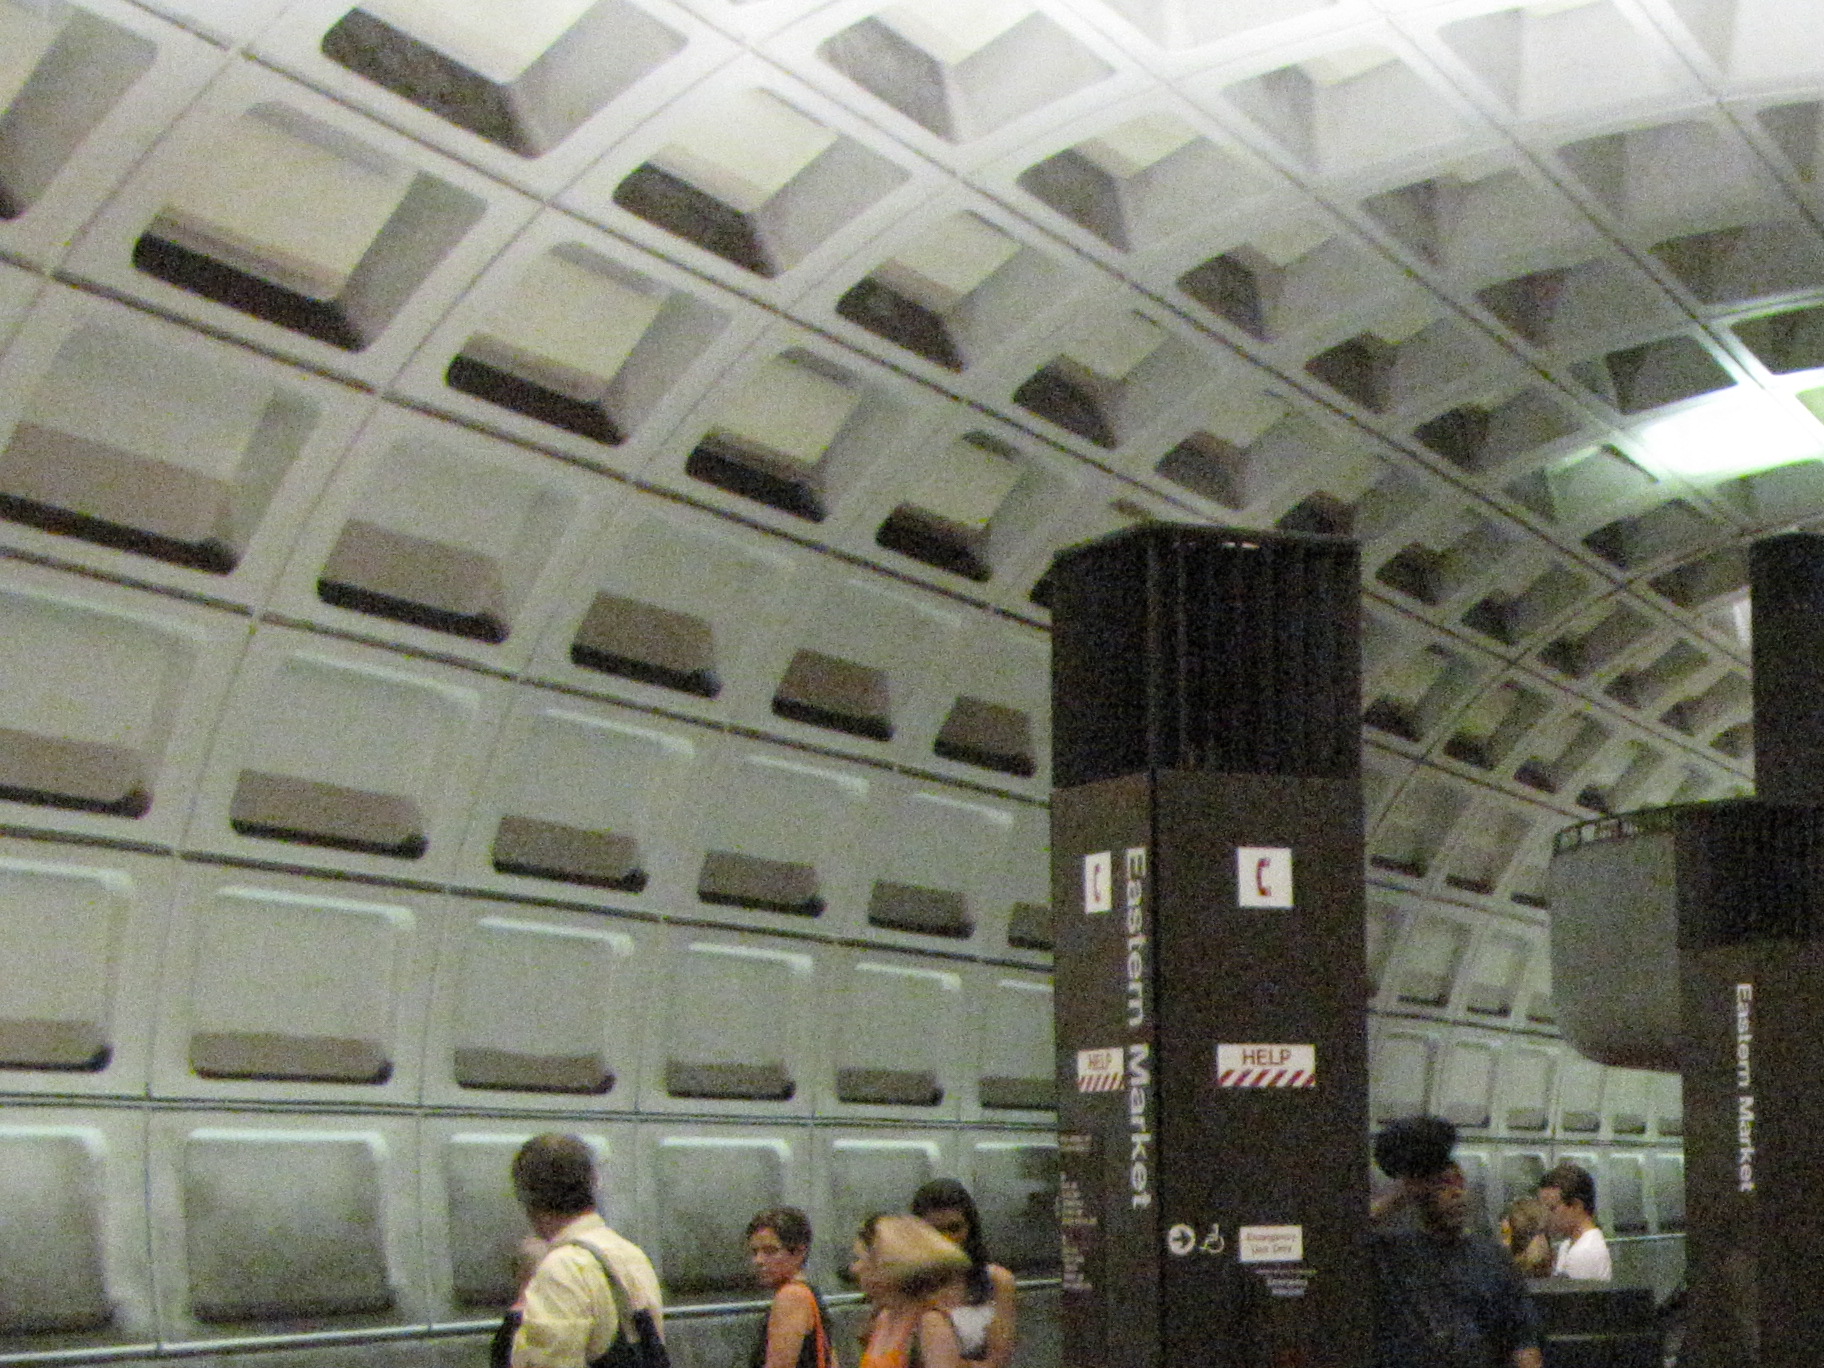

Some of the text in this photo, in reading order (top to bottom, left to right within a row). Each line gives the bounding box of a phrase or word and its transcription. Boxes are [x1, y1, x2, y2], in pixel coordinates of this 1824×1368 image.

[1088, 1053, 1112, 1071] HELP
[1126, 847, 1152, 1208] Eastern Market
[1241, 1049, 1292, 1066] HELP
[1737, 984, 1754, 1191] Eastern Market
